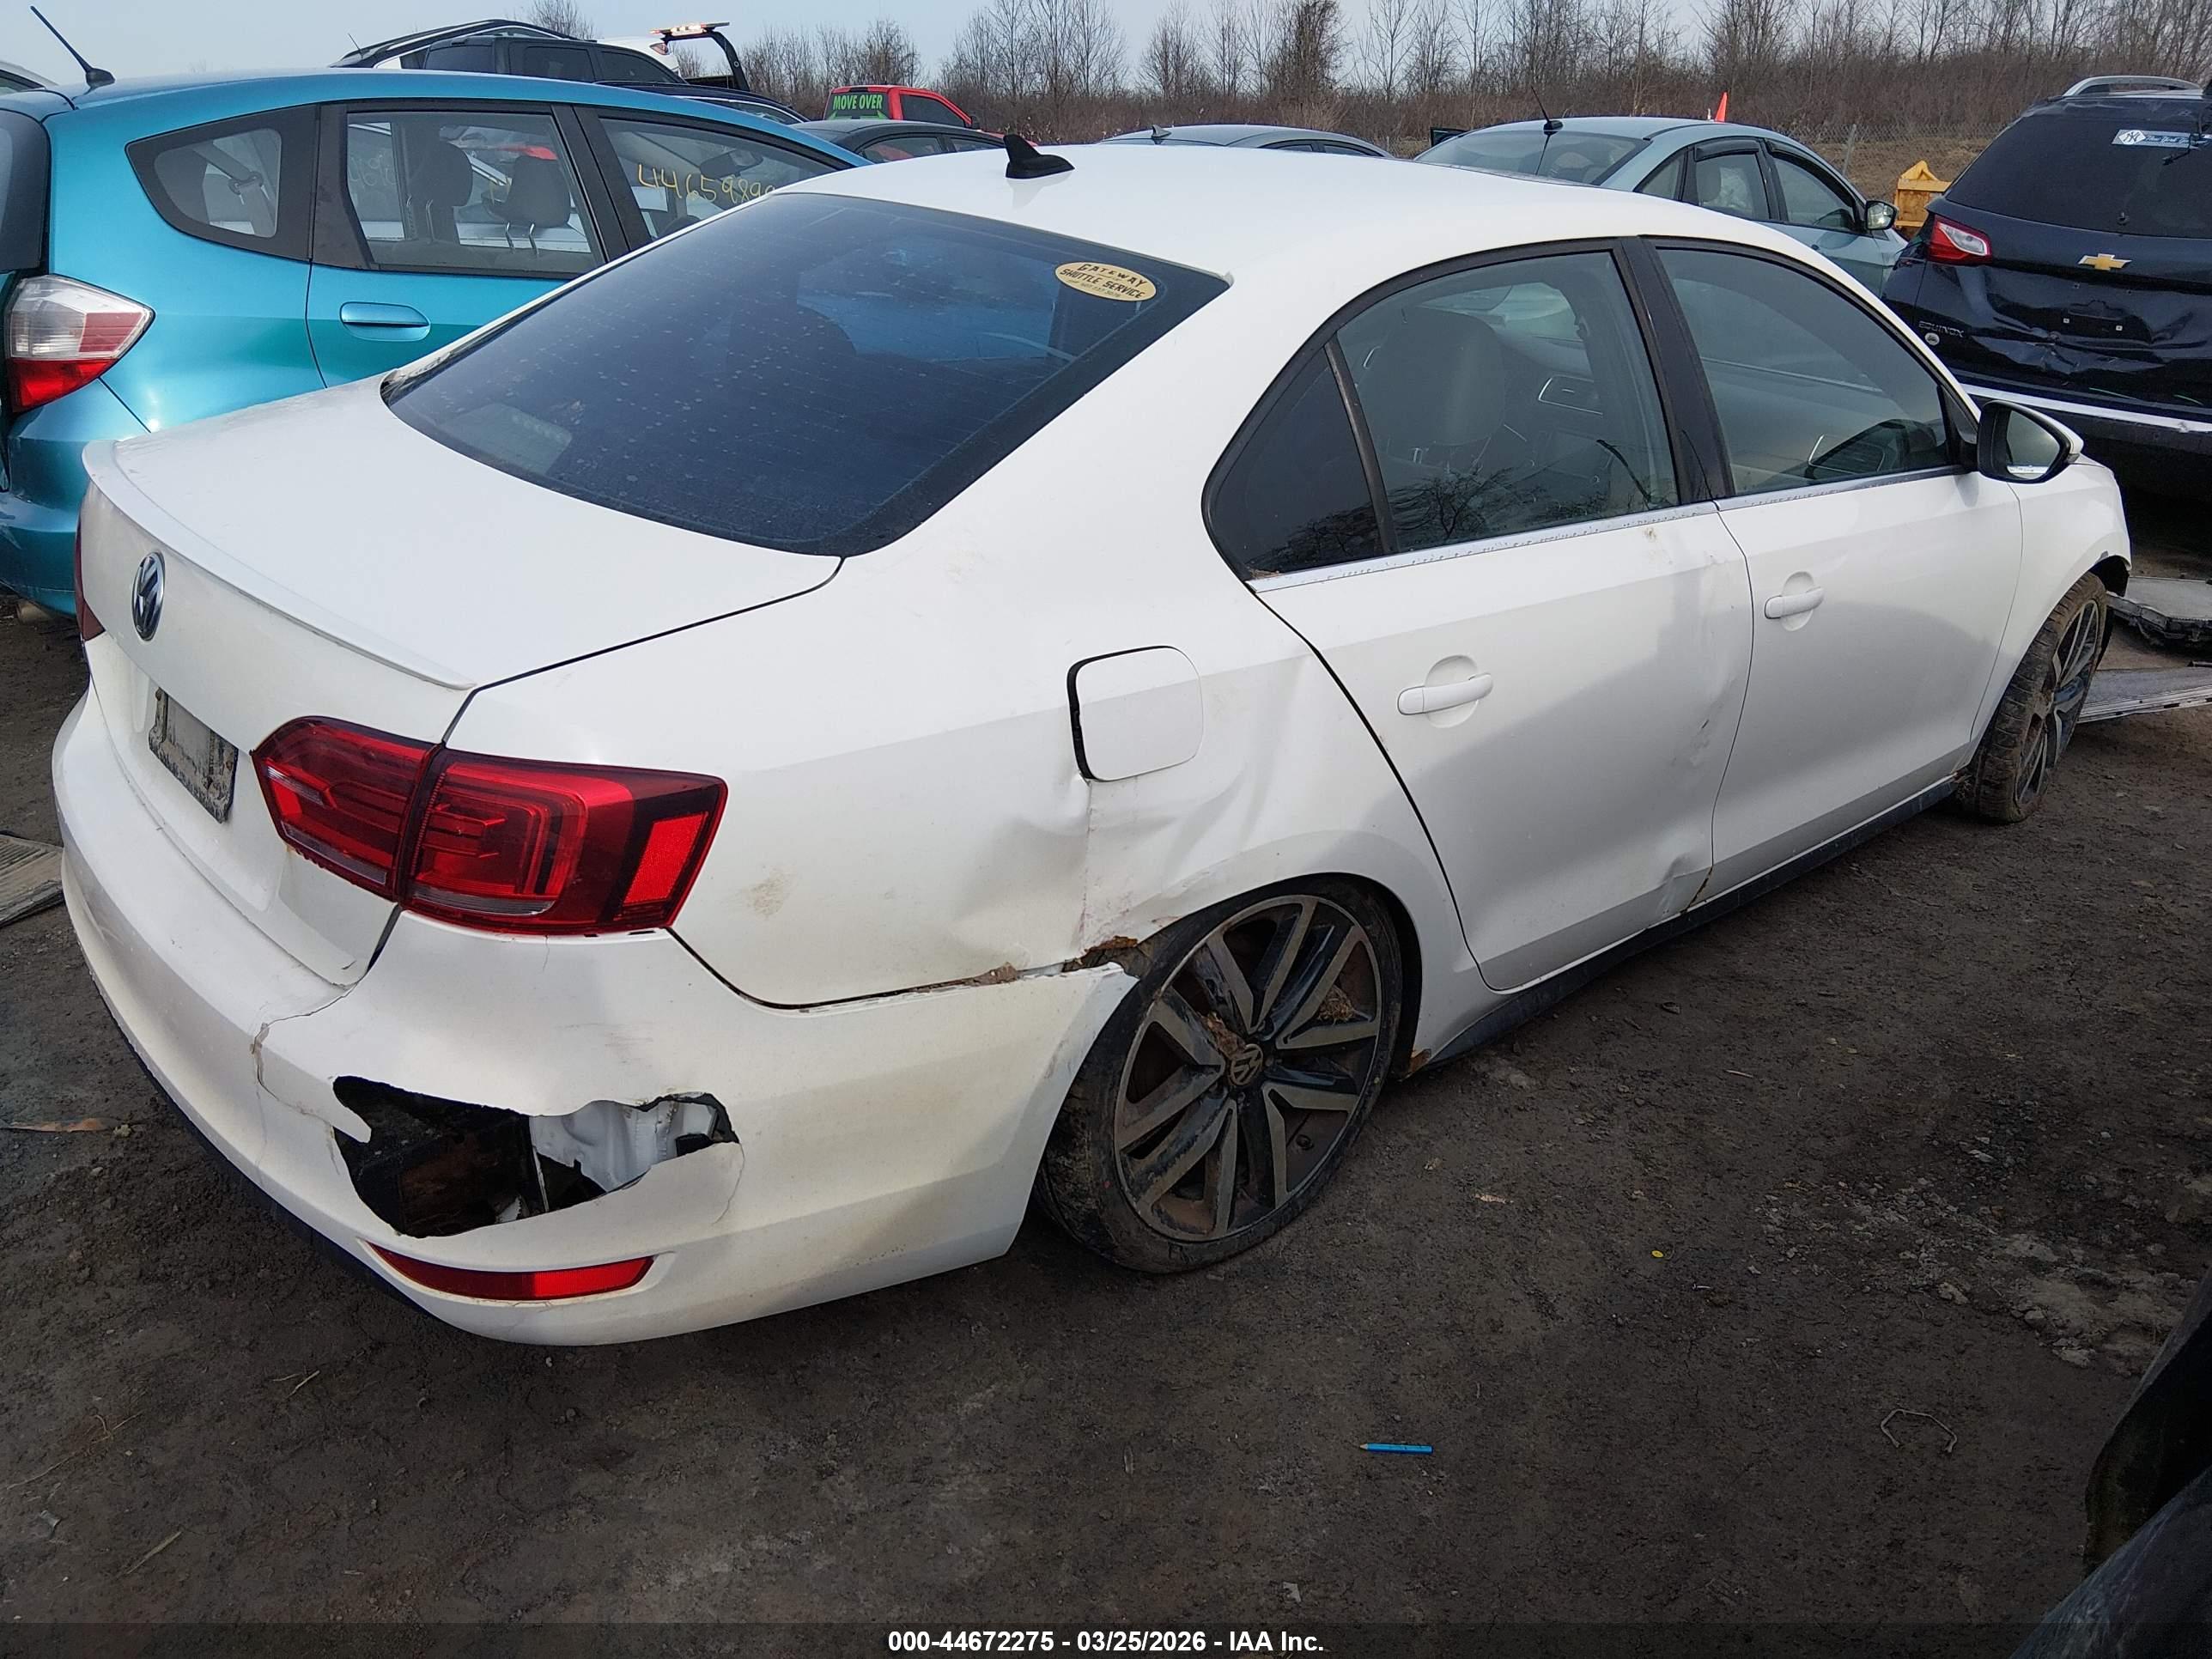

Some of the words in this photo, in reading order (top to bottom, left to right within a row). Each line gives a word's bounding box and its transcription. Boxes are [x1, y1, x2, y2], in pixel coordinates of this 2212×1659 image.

[832, 94, 858, 111] MOVE
[859, 94, 884, 110] OVER
[1059, 268, 1103, 284] SHUTTLE
[1102, 280, 1146, 299] SERVICE
[1076, 263, 1148, 288] GATEWAY
